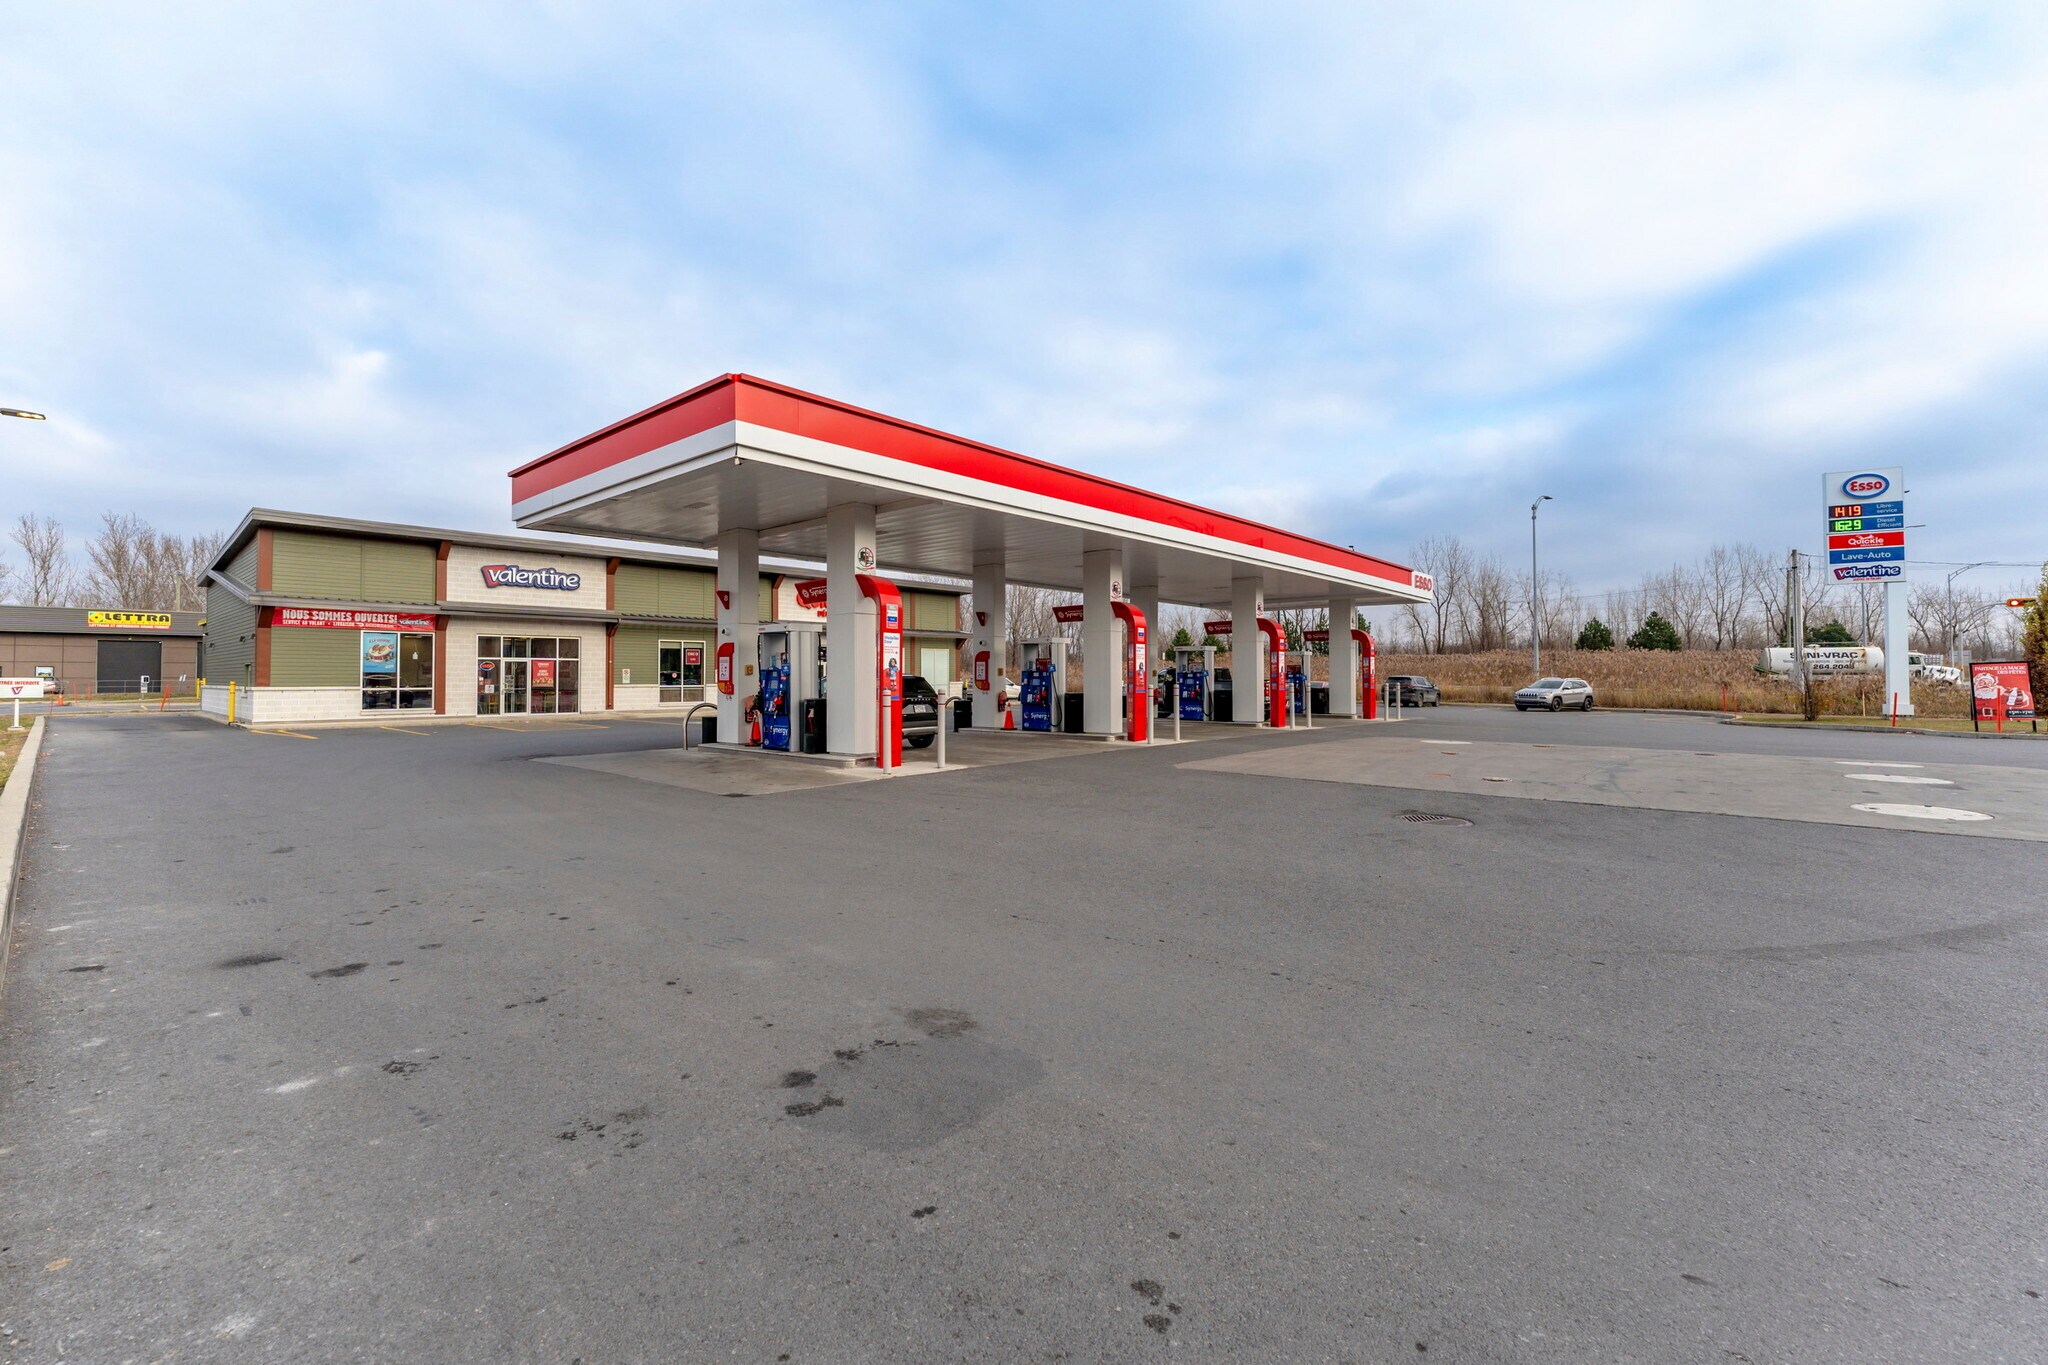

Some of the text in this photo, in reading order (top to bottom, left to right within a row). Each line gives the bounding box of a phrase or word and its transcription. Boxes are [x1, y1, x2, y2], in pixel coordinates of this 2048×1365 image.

[1850, 481, 1883, 492] Esso
[1841, 551, 1891, 560] Lave-Auto
[1414, 575, 1432, 591] ESSO
[723, 594, 729, 602] 8
[105, 613, 170, 622] LETTRA
[282, 609, 398, 623] NOUS SOMMES OUVERTS!
[1790, 651, 1858, 659] SNI-VRAC
